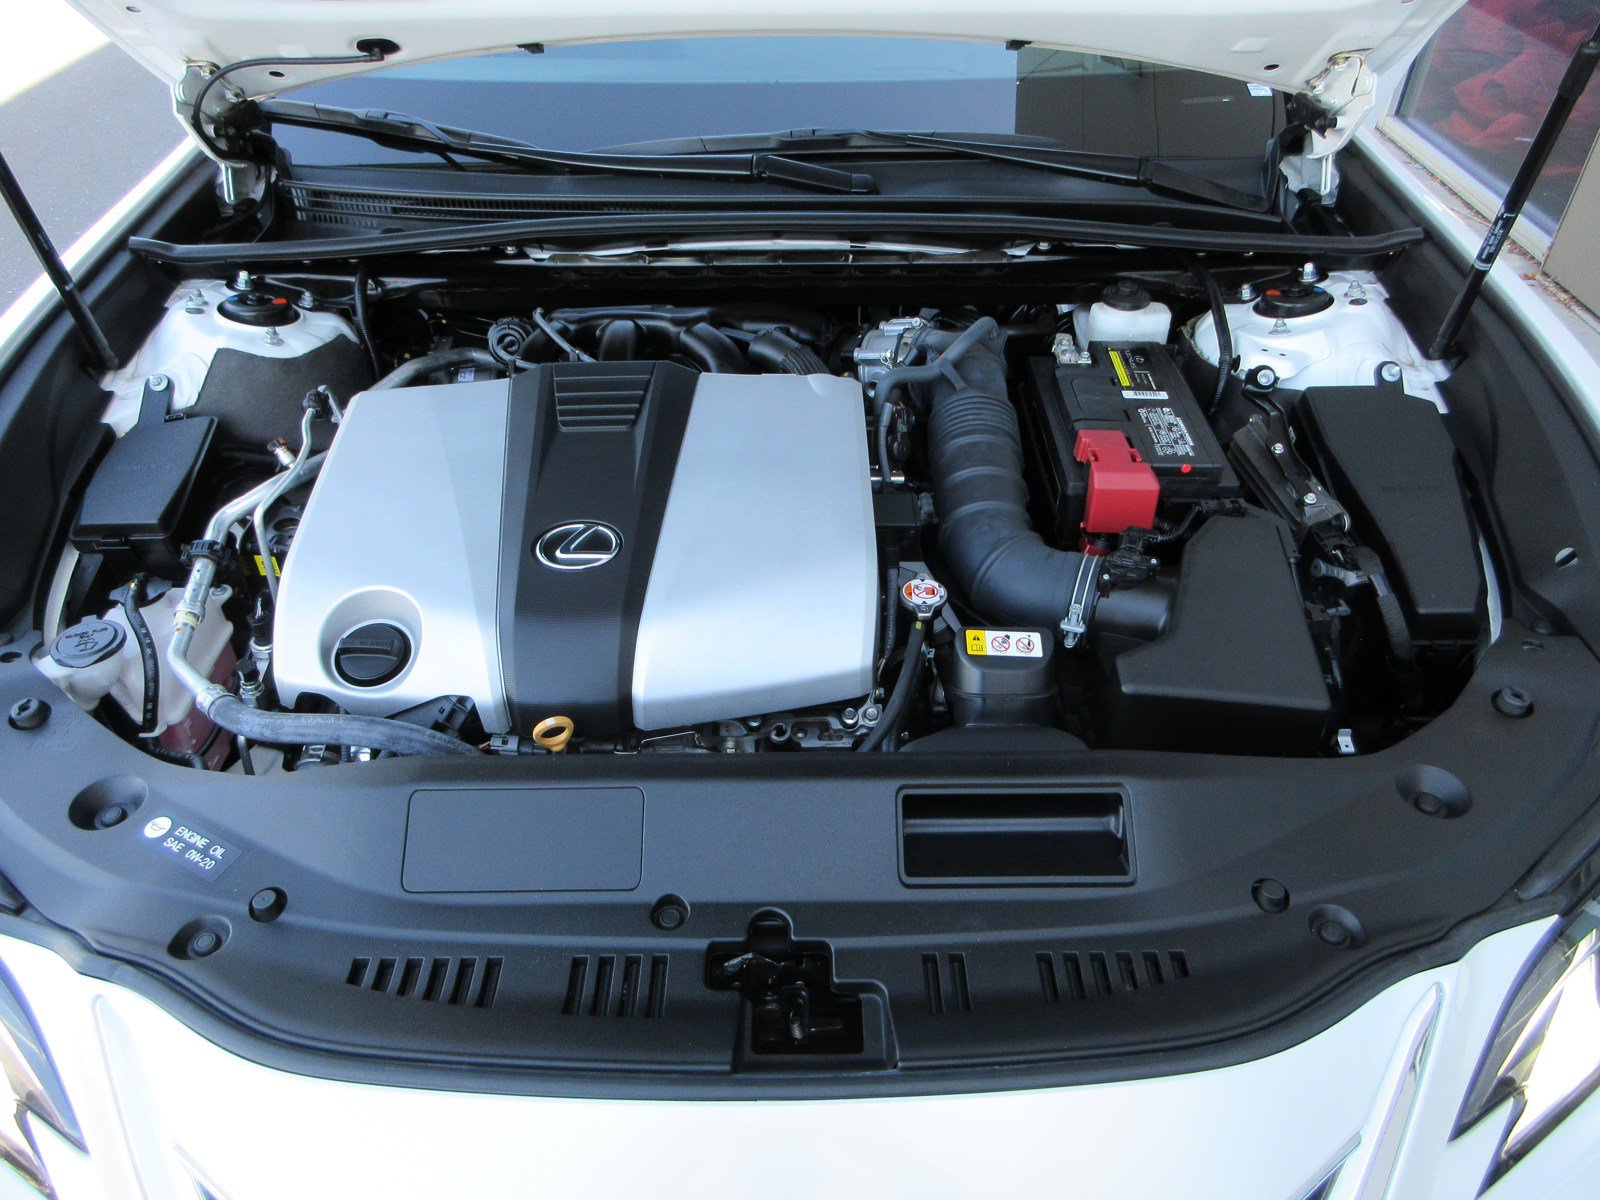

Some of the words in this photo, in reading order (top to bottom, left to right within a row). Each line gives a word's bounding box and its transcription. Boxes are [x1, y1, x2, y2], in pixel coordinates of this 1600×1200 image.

[163, 837, 186, 853] SAE
[185, 849, 216, 870] 0W-20
[175, 826, 210, 849] ENGINE
[209, 845, 226, 859] OIL
